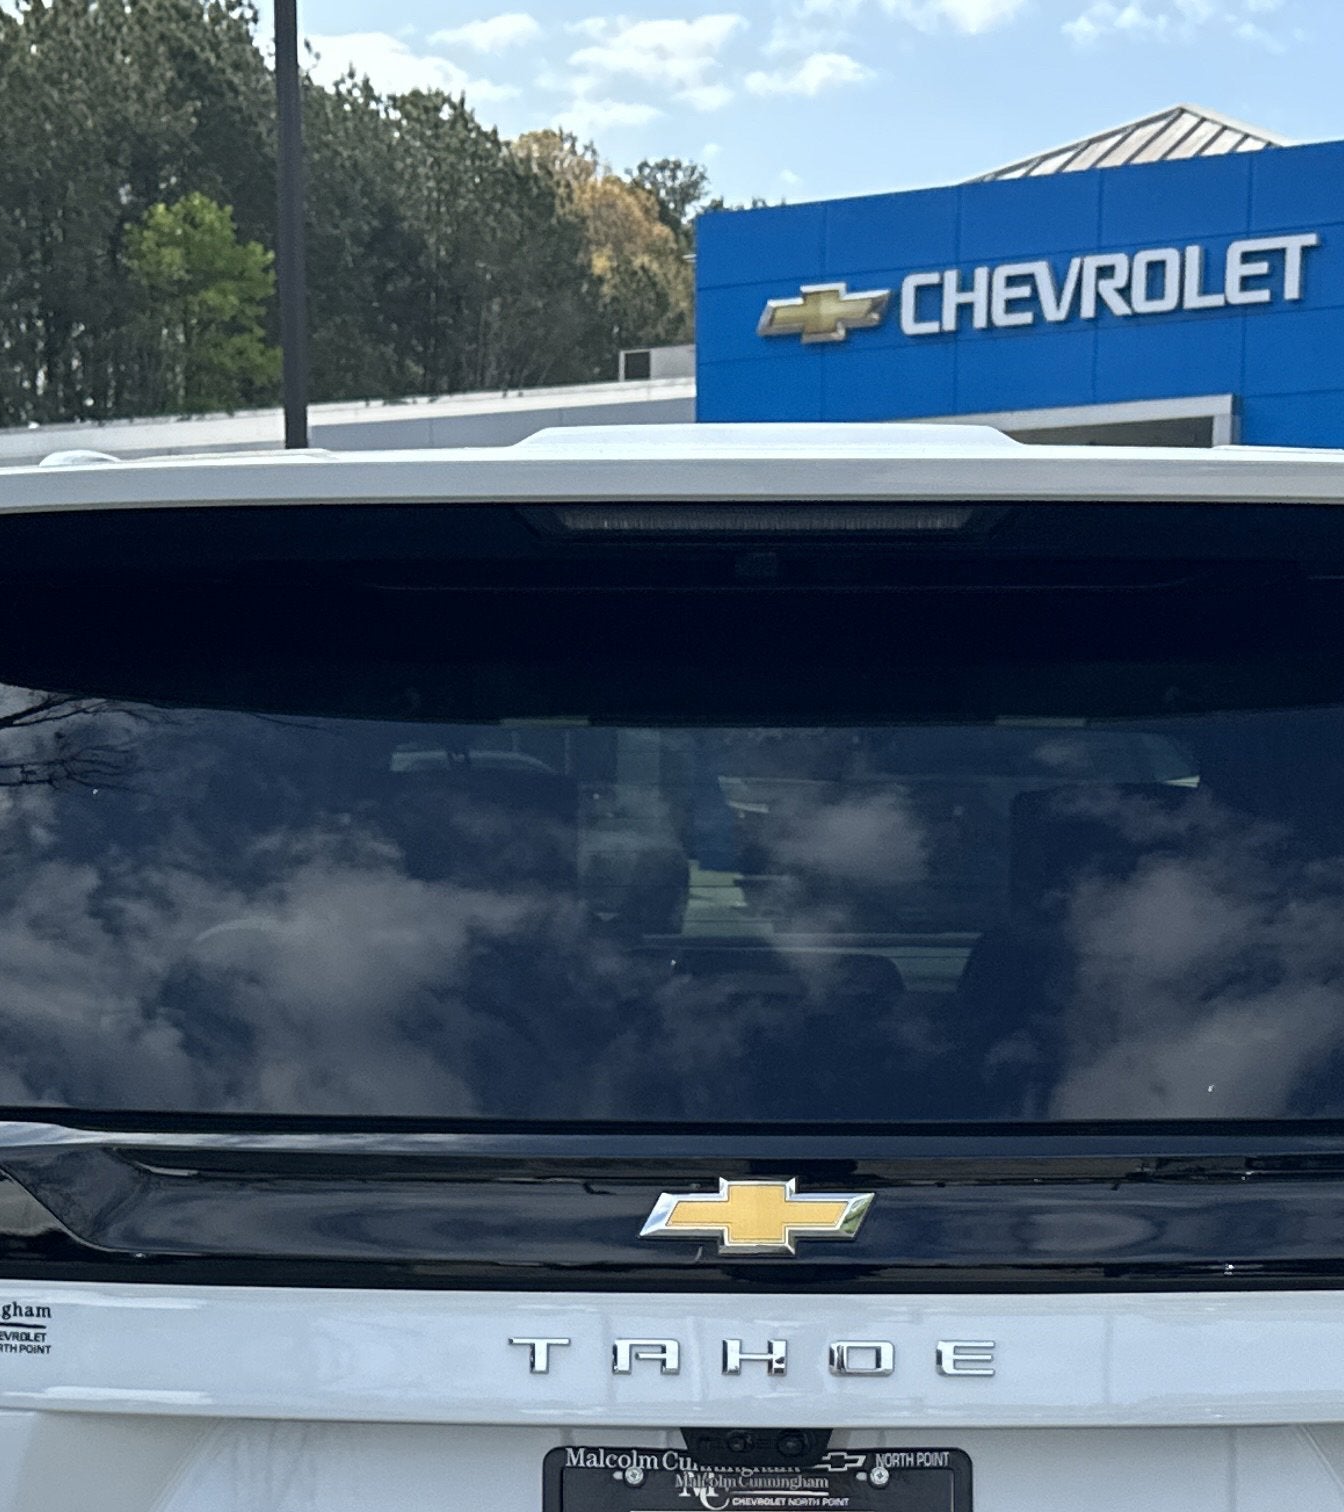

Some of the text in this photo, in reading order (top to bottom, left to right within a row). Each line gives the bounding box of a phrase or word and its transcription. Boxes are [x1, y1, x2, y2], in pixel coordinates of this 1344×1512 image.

[900, 232, 1319, 336] CHEVROLET
[507, 1336, 997, 1376] TAHOE
[565, 1447, 659, 1470] Malcolm
[875, 1451, 950, 1468] NORTH POINT
[675, 1473, 829, 1490] Malcolm Cunningham
[732, 1497, 849, 1506] CHEVROLET NORTH POINT
